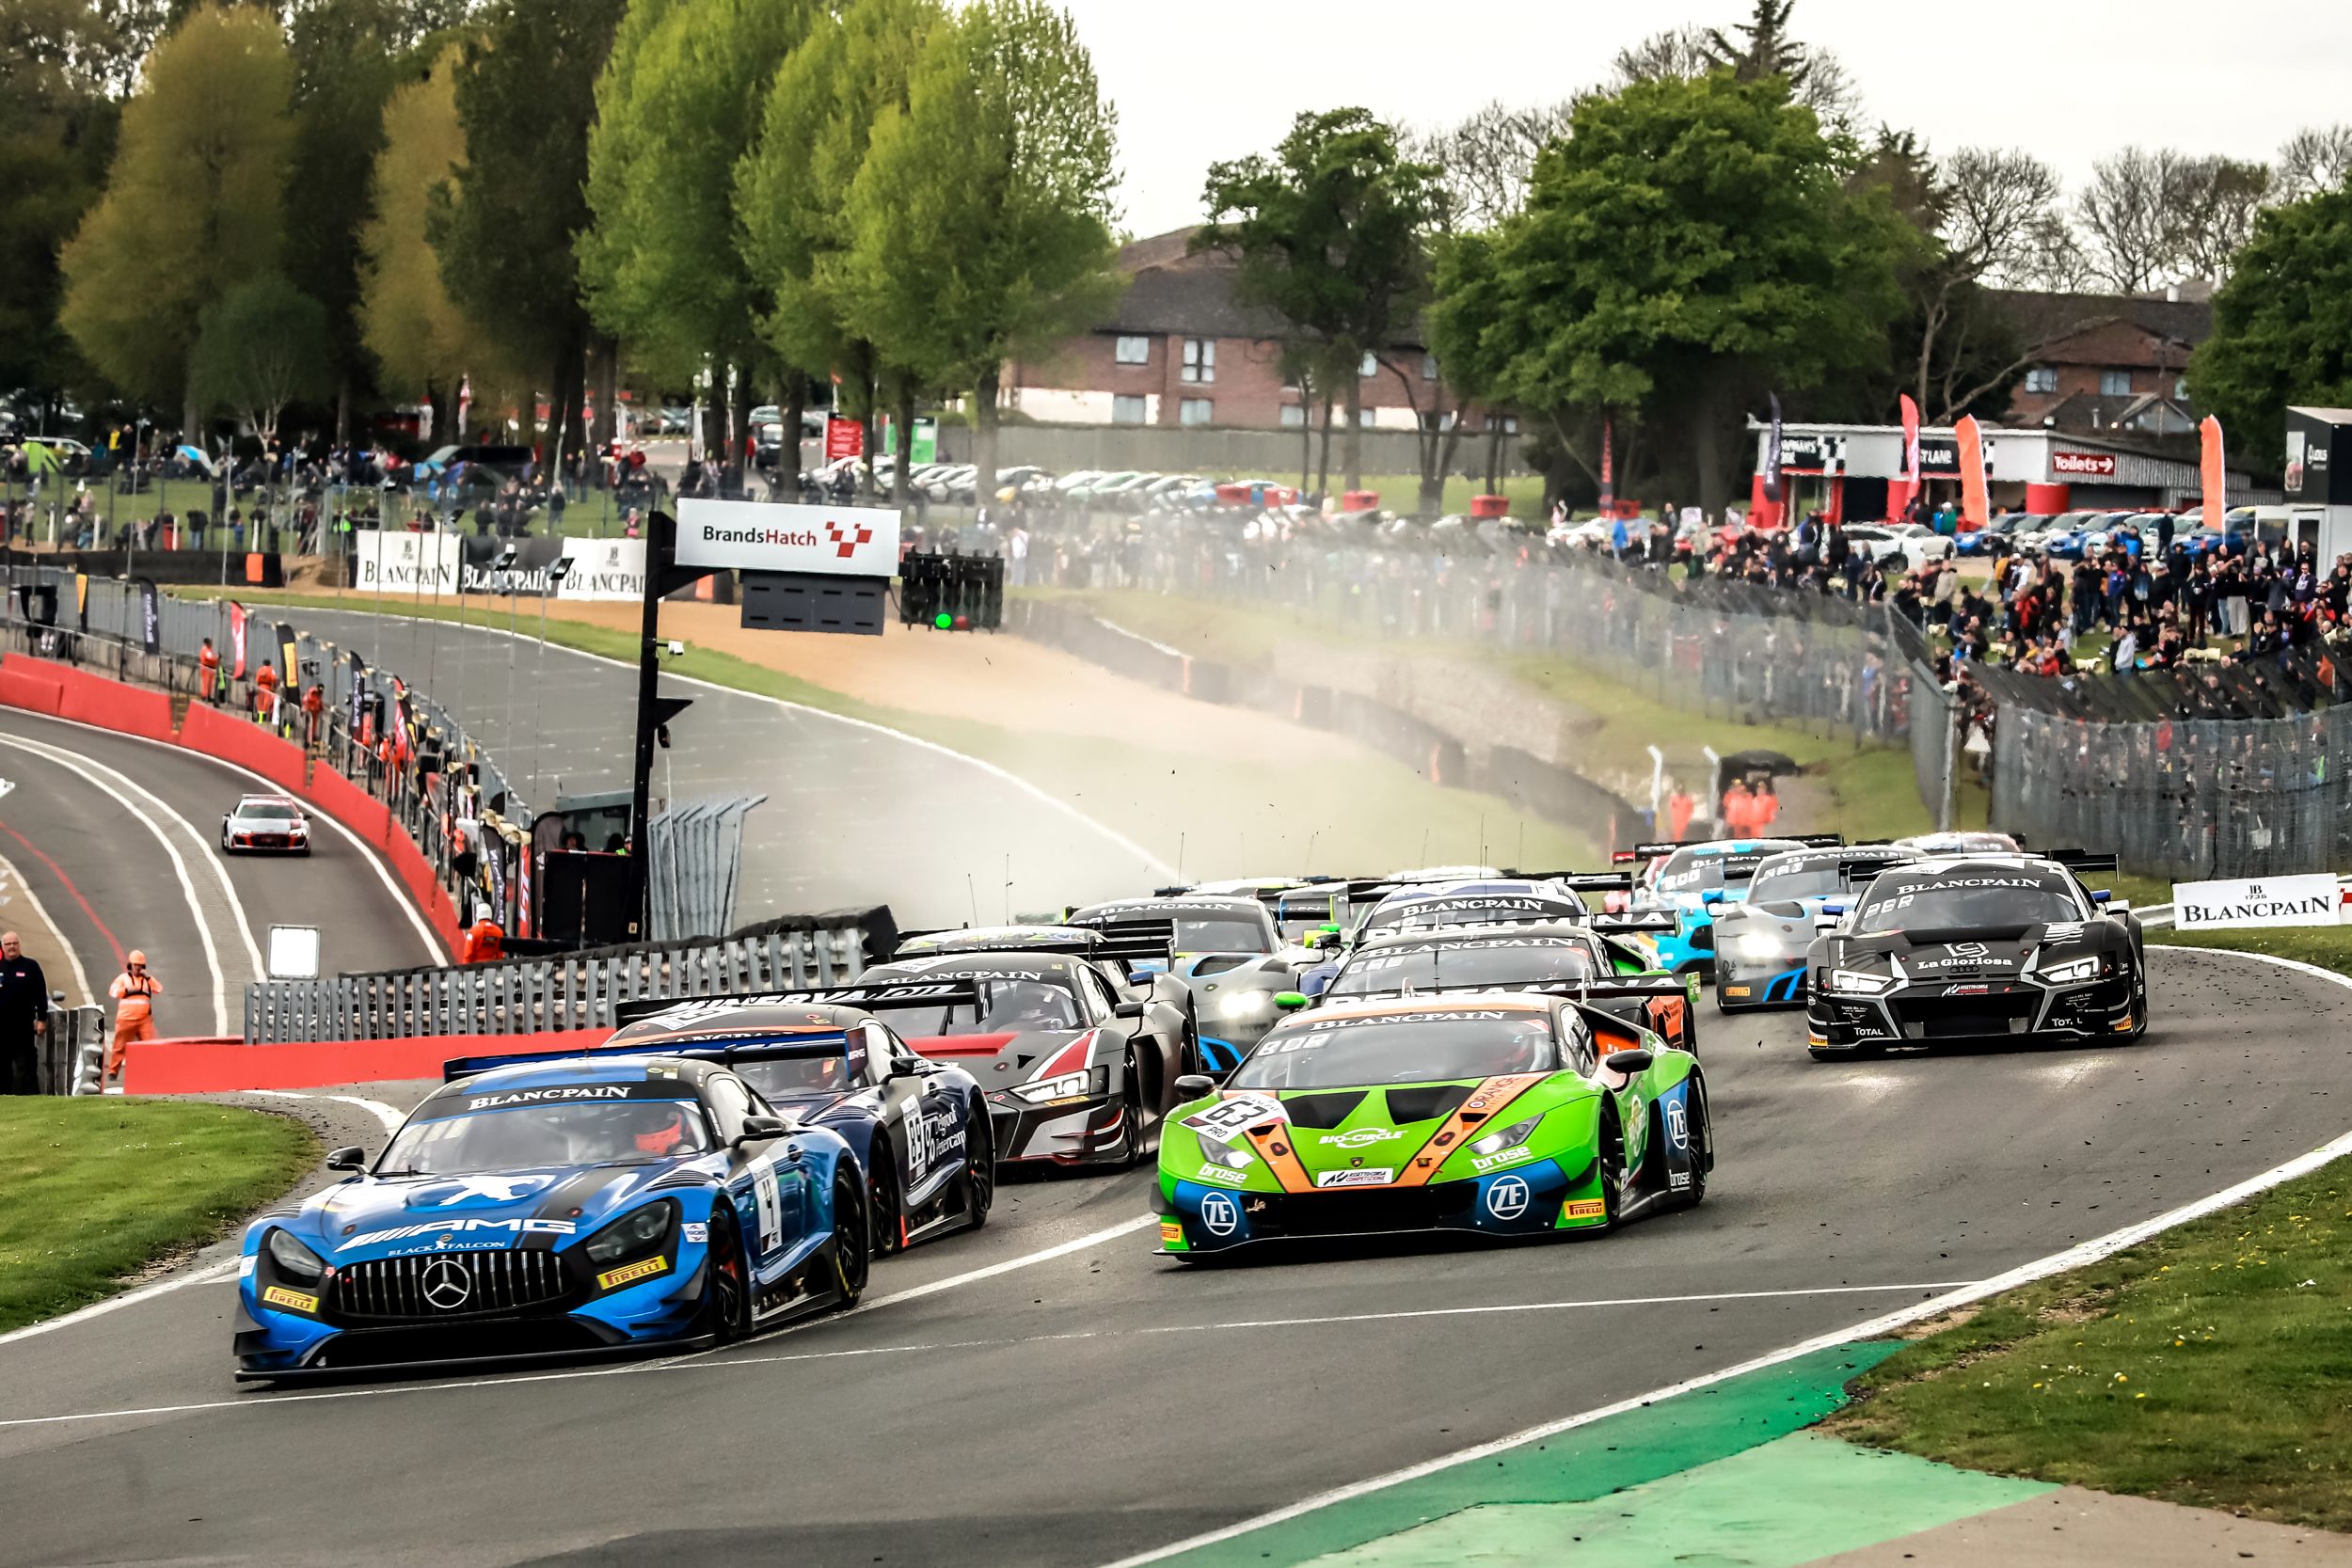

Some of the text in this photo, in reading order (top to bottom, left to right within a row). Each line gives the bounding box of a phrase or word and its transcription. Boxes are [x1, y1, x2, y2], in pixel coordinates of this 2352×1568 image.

[2055, 455, 2098, 471] Toilets
[703, 526, 818, 546] BrandsHatch
[364, 560, 450, 585] BLANCPAIN
[565, 569, 644, 593] BLANCPAI
[1896, 878, 2042, 895] BLANCPAIN
[1098, 903, 1234, 917] BLANCPAIN
[1401, 898, 1544, 918] BLANCPAIN
[2183, 895, 2329, 923] BLANCPAIN
[1363, 937, 1575, 958] BLANCPAIN
[1917, 958, 2012, 970] La Gloriosa
[880, 970, 1043, 987] BLANCPAIN
[1310, 1011, 1507, 1031] BLANCPAIN
[2052, 1017, 2083, 1027] TOTL
[1853, 1027, 1884, 1036] TOTAL
[468, 1085, 631, 1111] BLANCPAIN
[1205, 1101, 1269, 1127] 63
[909, 1117, 922, 1164] 89
[1208, 1126, 1229, 1138] PRO
[1319, 1130, 1406, 1145] BIO-CIRCLE
[1470, 1146, 1532, 1170] brose
[1198, 1163, 1248, 1183] brose
[1668, 1168, 1691, 1186] brose
[1569, 1202, 1602, 1216] PIRELLI
[388, 1241, 505, 1257] BLACK FALCON
[605, 1259, 661, 1286] PIRELLI
[269, 1289, 312, 1310] PIRELLI
